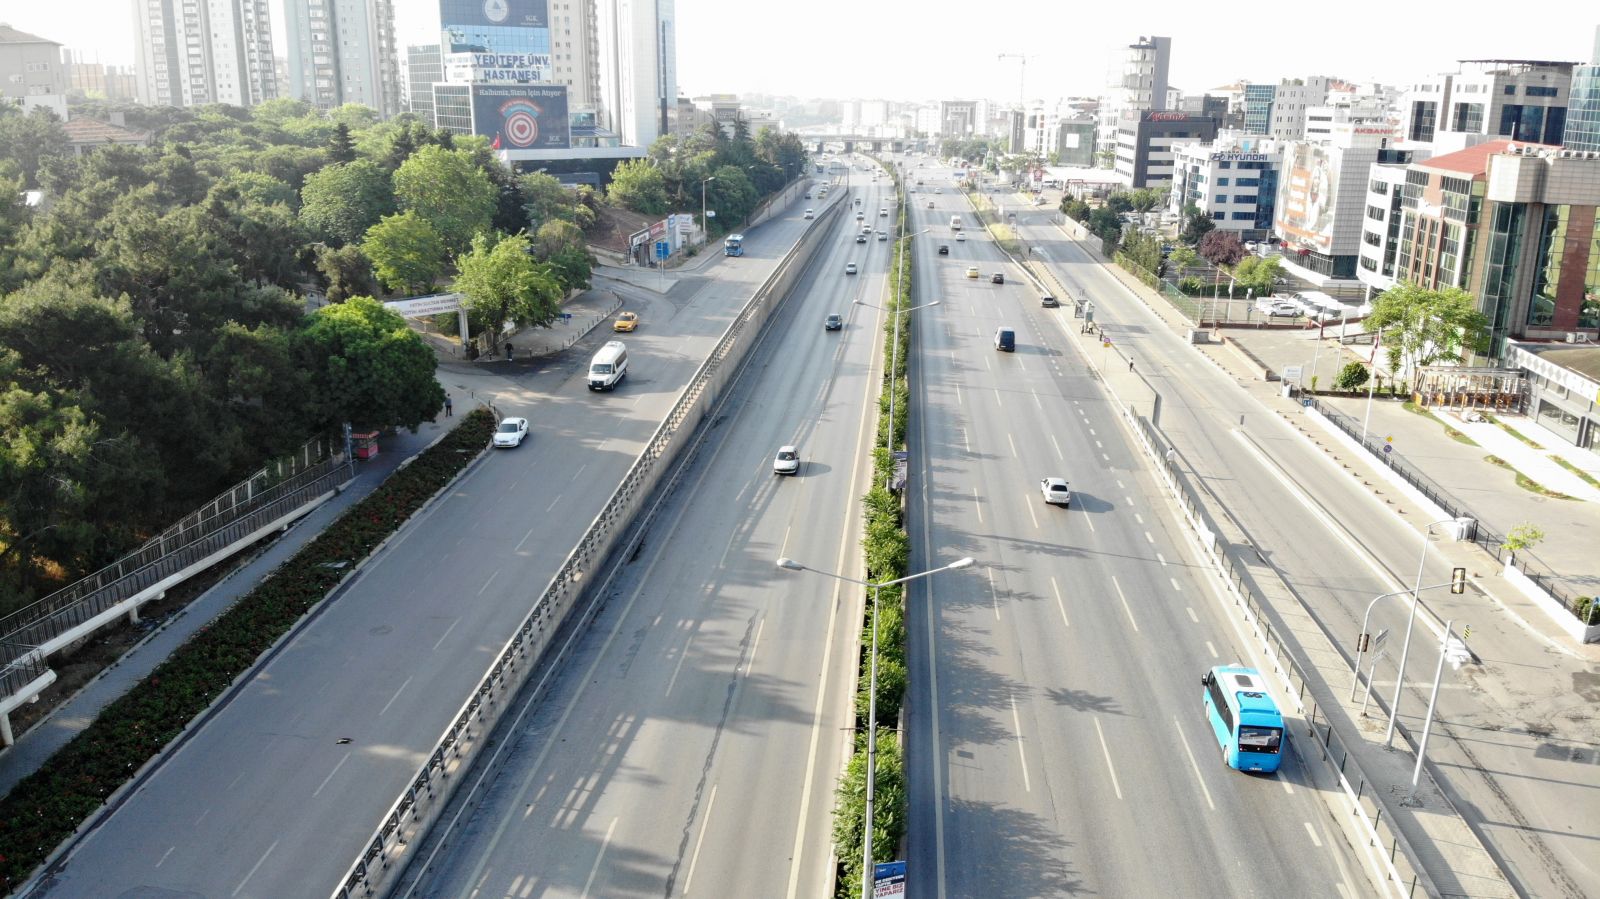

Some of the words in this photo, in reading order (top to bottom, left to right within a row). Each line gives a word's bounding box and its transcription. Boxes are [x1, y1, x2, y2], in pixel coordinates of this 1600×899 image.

[474, 52, 525, 66] YEDİTEPE
[527, 53, 550, 66] ÜNV.
[483, 69, 541, 81] HASTANESİ
[1353, 127, 1393, 135] AKBANK
[1227, 153, 1268, 161] HYUNDAI
